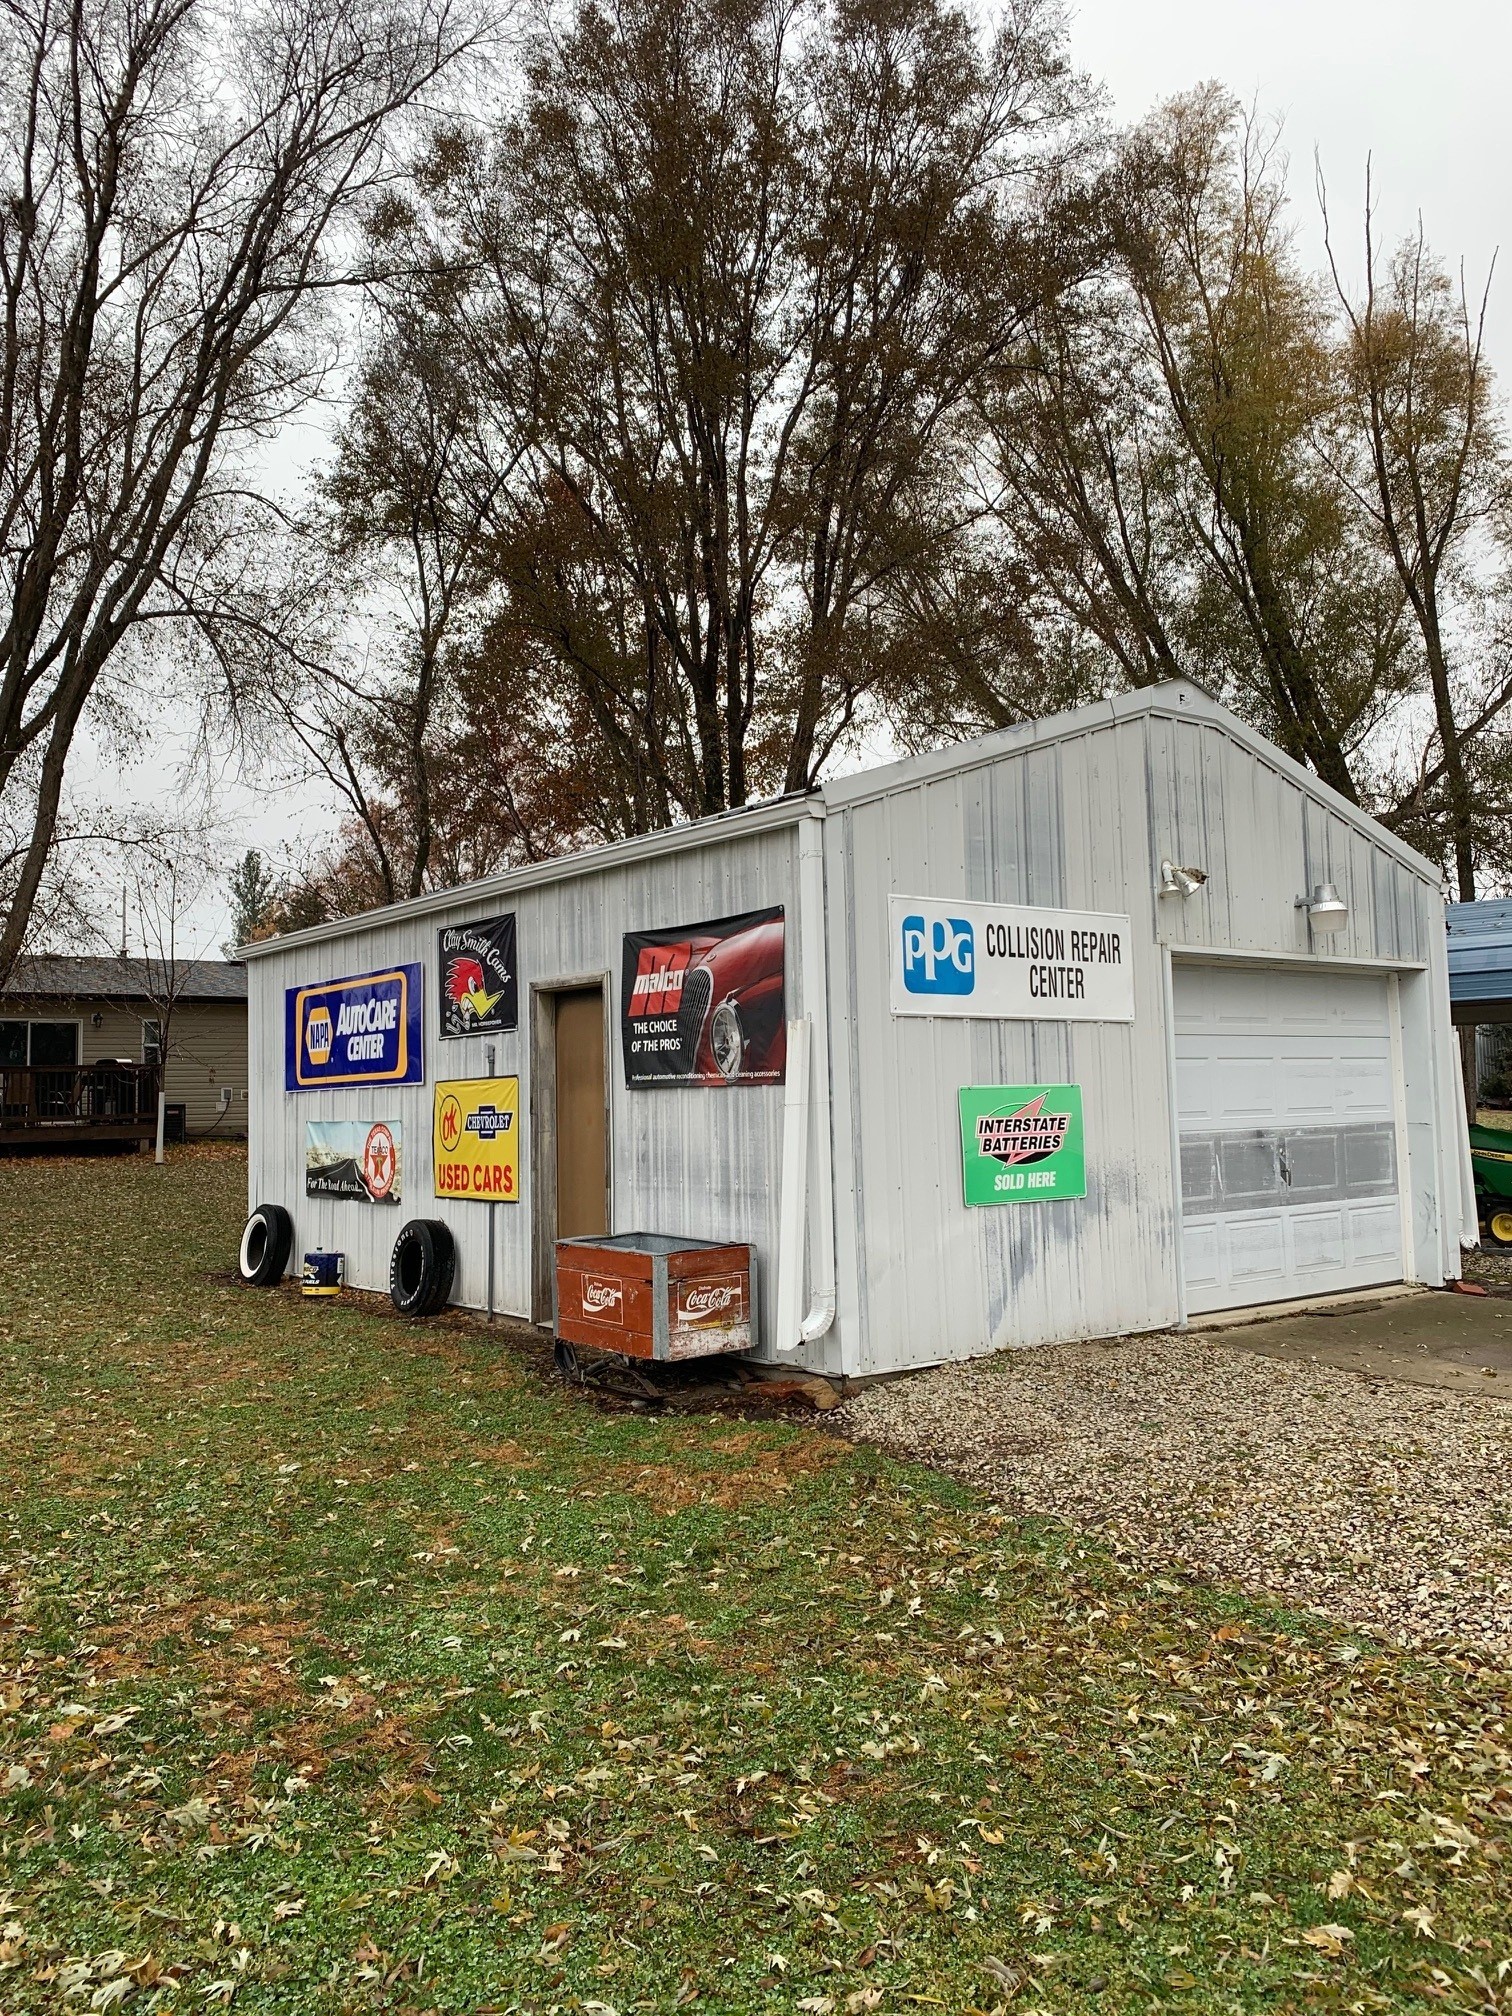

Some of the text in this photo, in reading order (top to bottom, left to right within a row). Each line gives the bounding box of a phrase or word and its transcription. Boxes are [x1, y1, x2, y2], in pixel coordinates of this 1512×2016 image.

[443, 929, 512, 983] Clay Smith Cams
[904, 916, 972, 981] PPG
[986, 924, 1121, 964] COLLISION REPAIR
[633, 965, 684, 995] malco
[1029, 965, 1085, 999] CENTER
[310, 1022, 329, 1050] NAPA
[633, 1019, 678, 1034] THE CHOICE
[347, 1034, 384, 1061] CENTER
[631, 1040, 644, 1052] OF
[643, 1039, 658, 1052] THE
[442, 1103, 458, 1142] OK
[467, 1115, 510, 1129] CHEVROLET
[979, 1117, 1067, 1134] INTERSTATE
[983, 1135, 1061, 1152] BATTERIES
[306, 1177, 317, 1189] For
[318, 1178, 328, 1190] The
[328, 1179, 340, 1191] Road
[438, 1163, 513, 1193] USED CARS
[994, 1171, 1056, 1191] SOLD HERE
[587, 1284, 616, 1307] Coca-Cola
[686, 1286, 732, 1310] Coca-Cola
